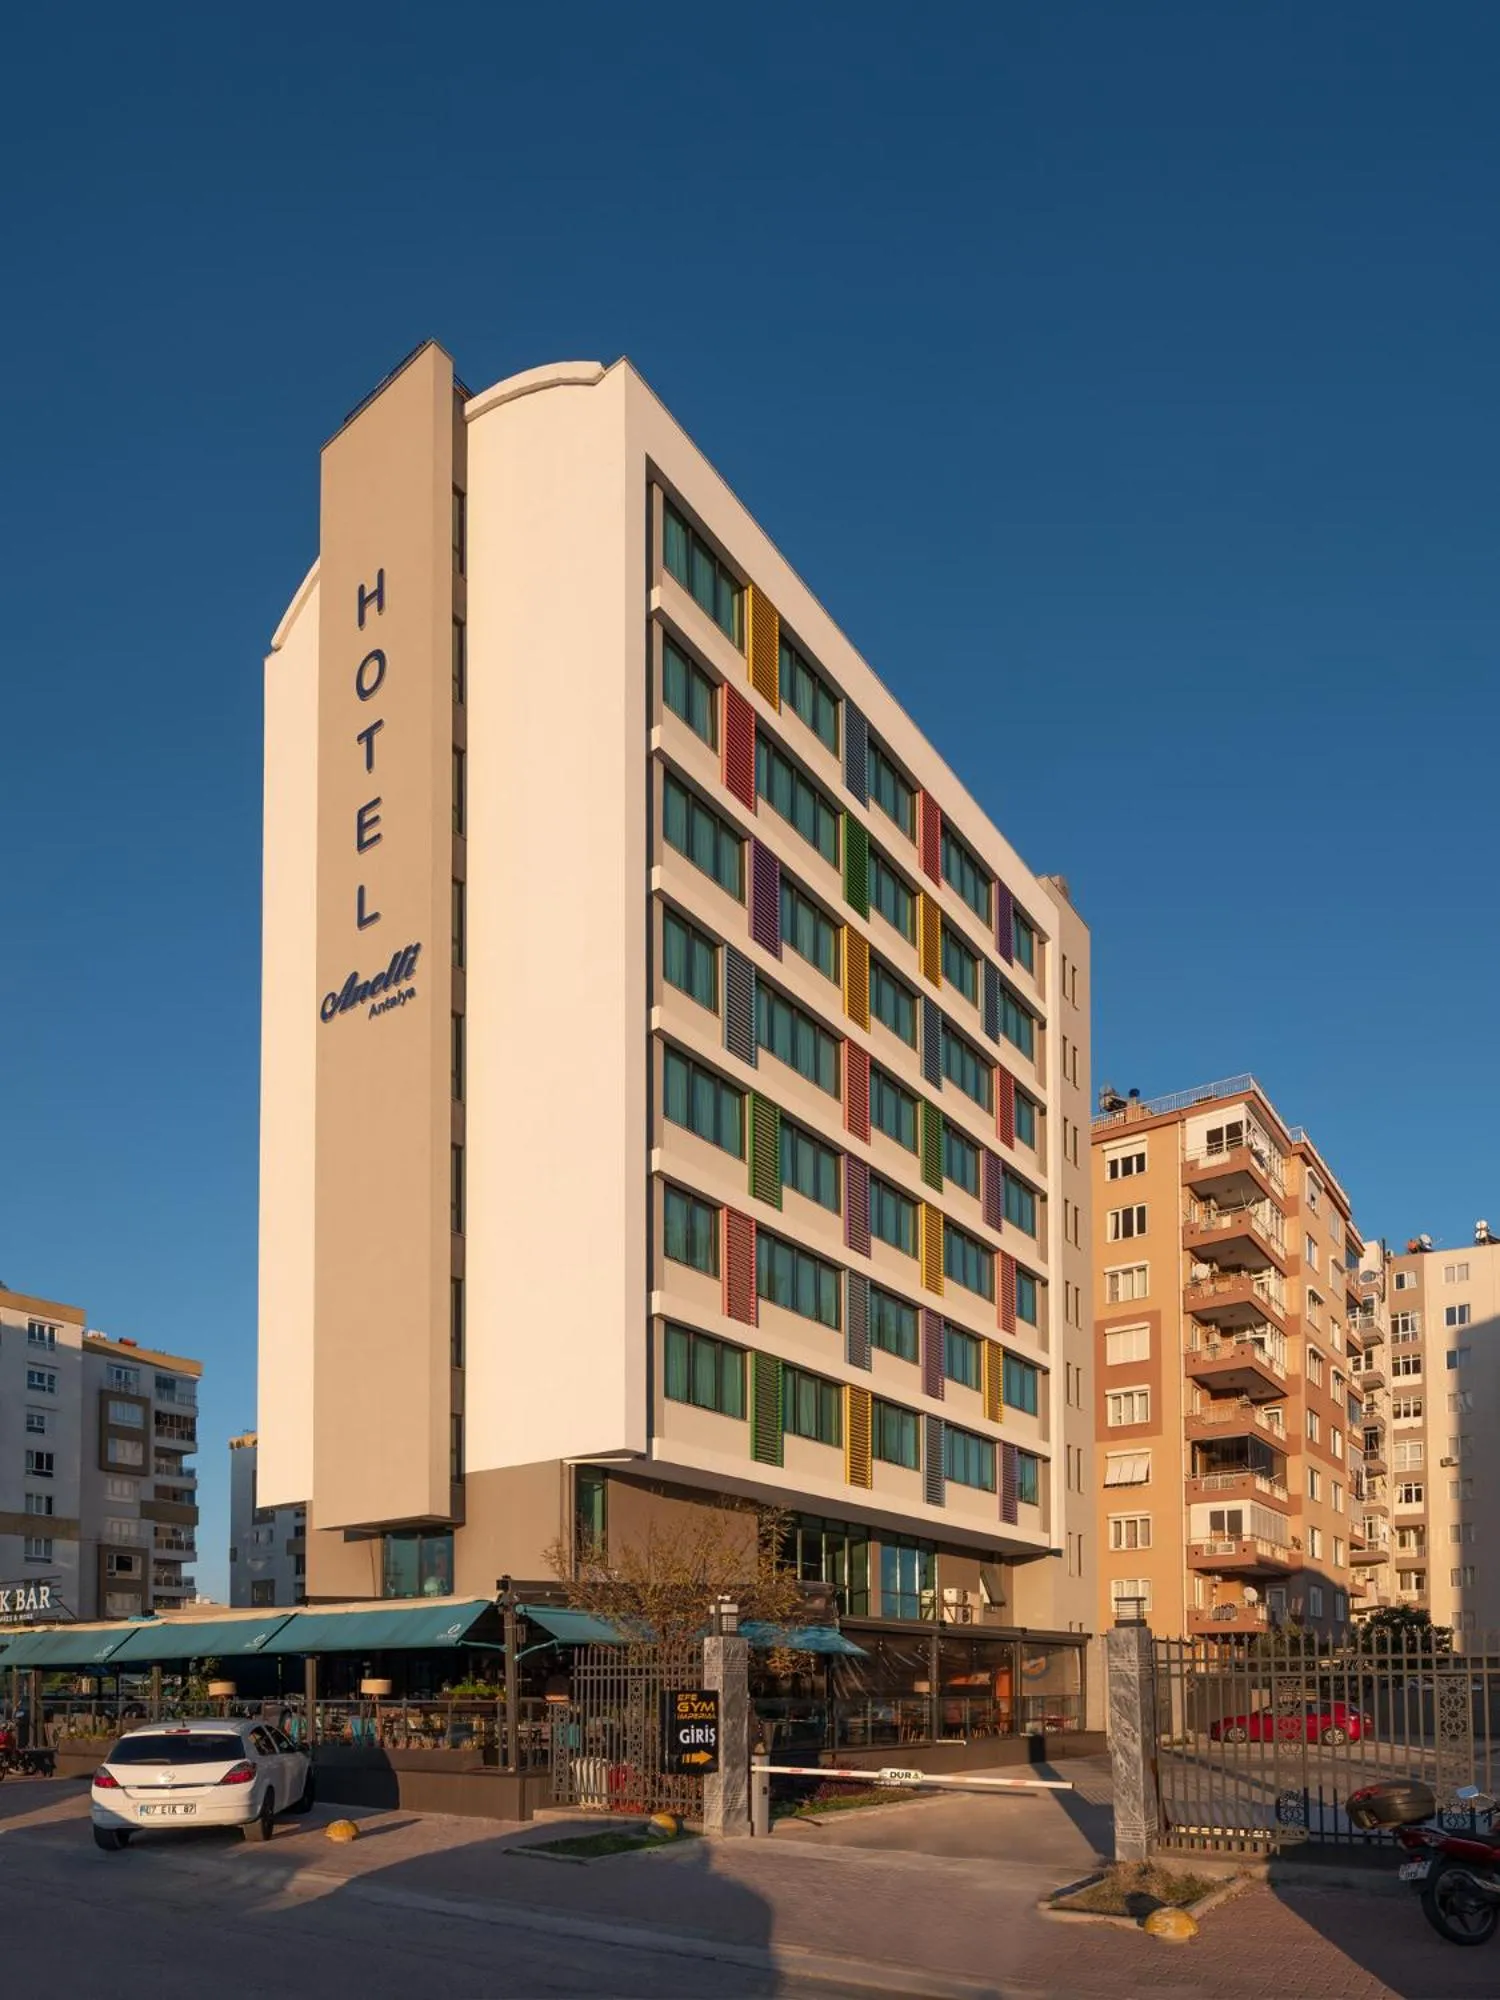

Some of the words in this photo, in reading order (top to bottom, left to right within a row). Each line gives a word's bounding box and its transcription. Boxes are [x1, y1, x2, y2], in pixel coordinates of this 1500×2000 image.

[356, 567, 387, 931] HOTEL
[16, 1586, 50, 1611] BAR
[677, 1701, 715, 1712] GYM
[679, 1724, 716, 1747] GİRİŞ
